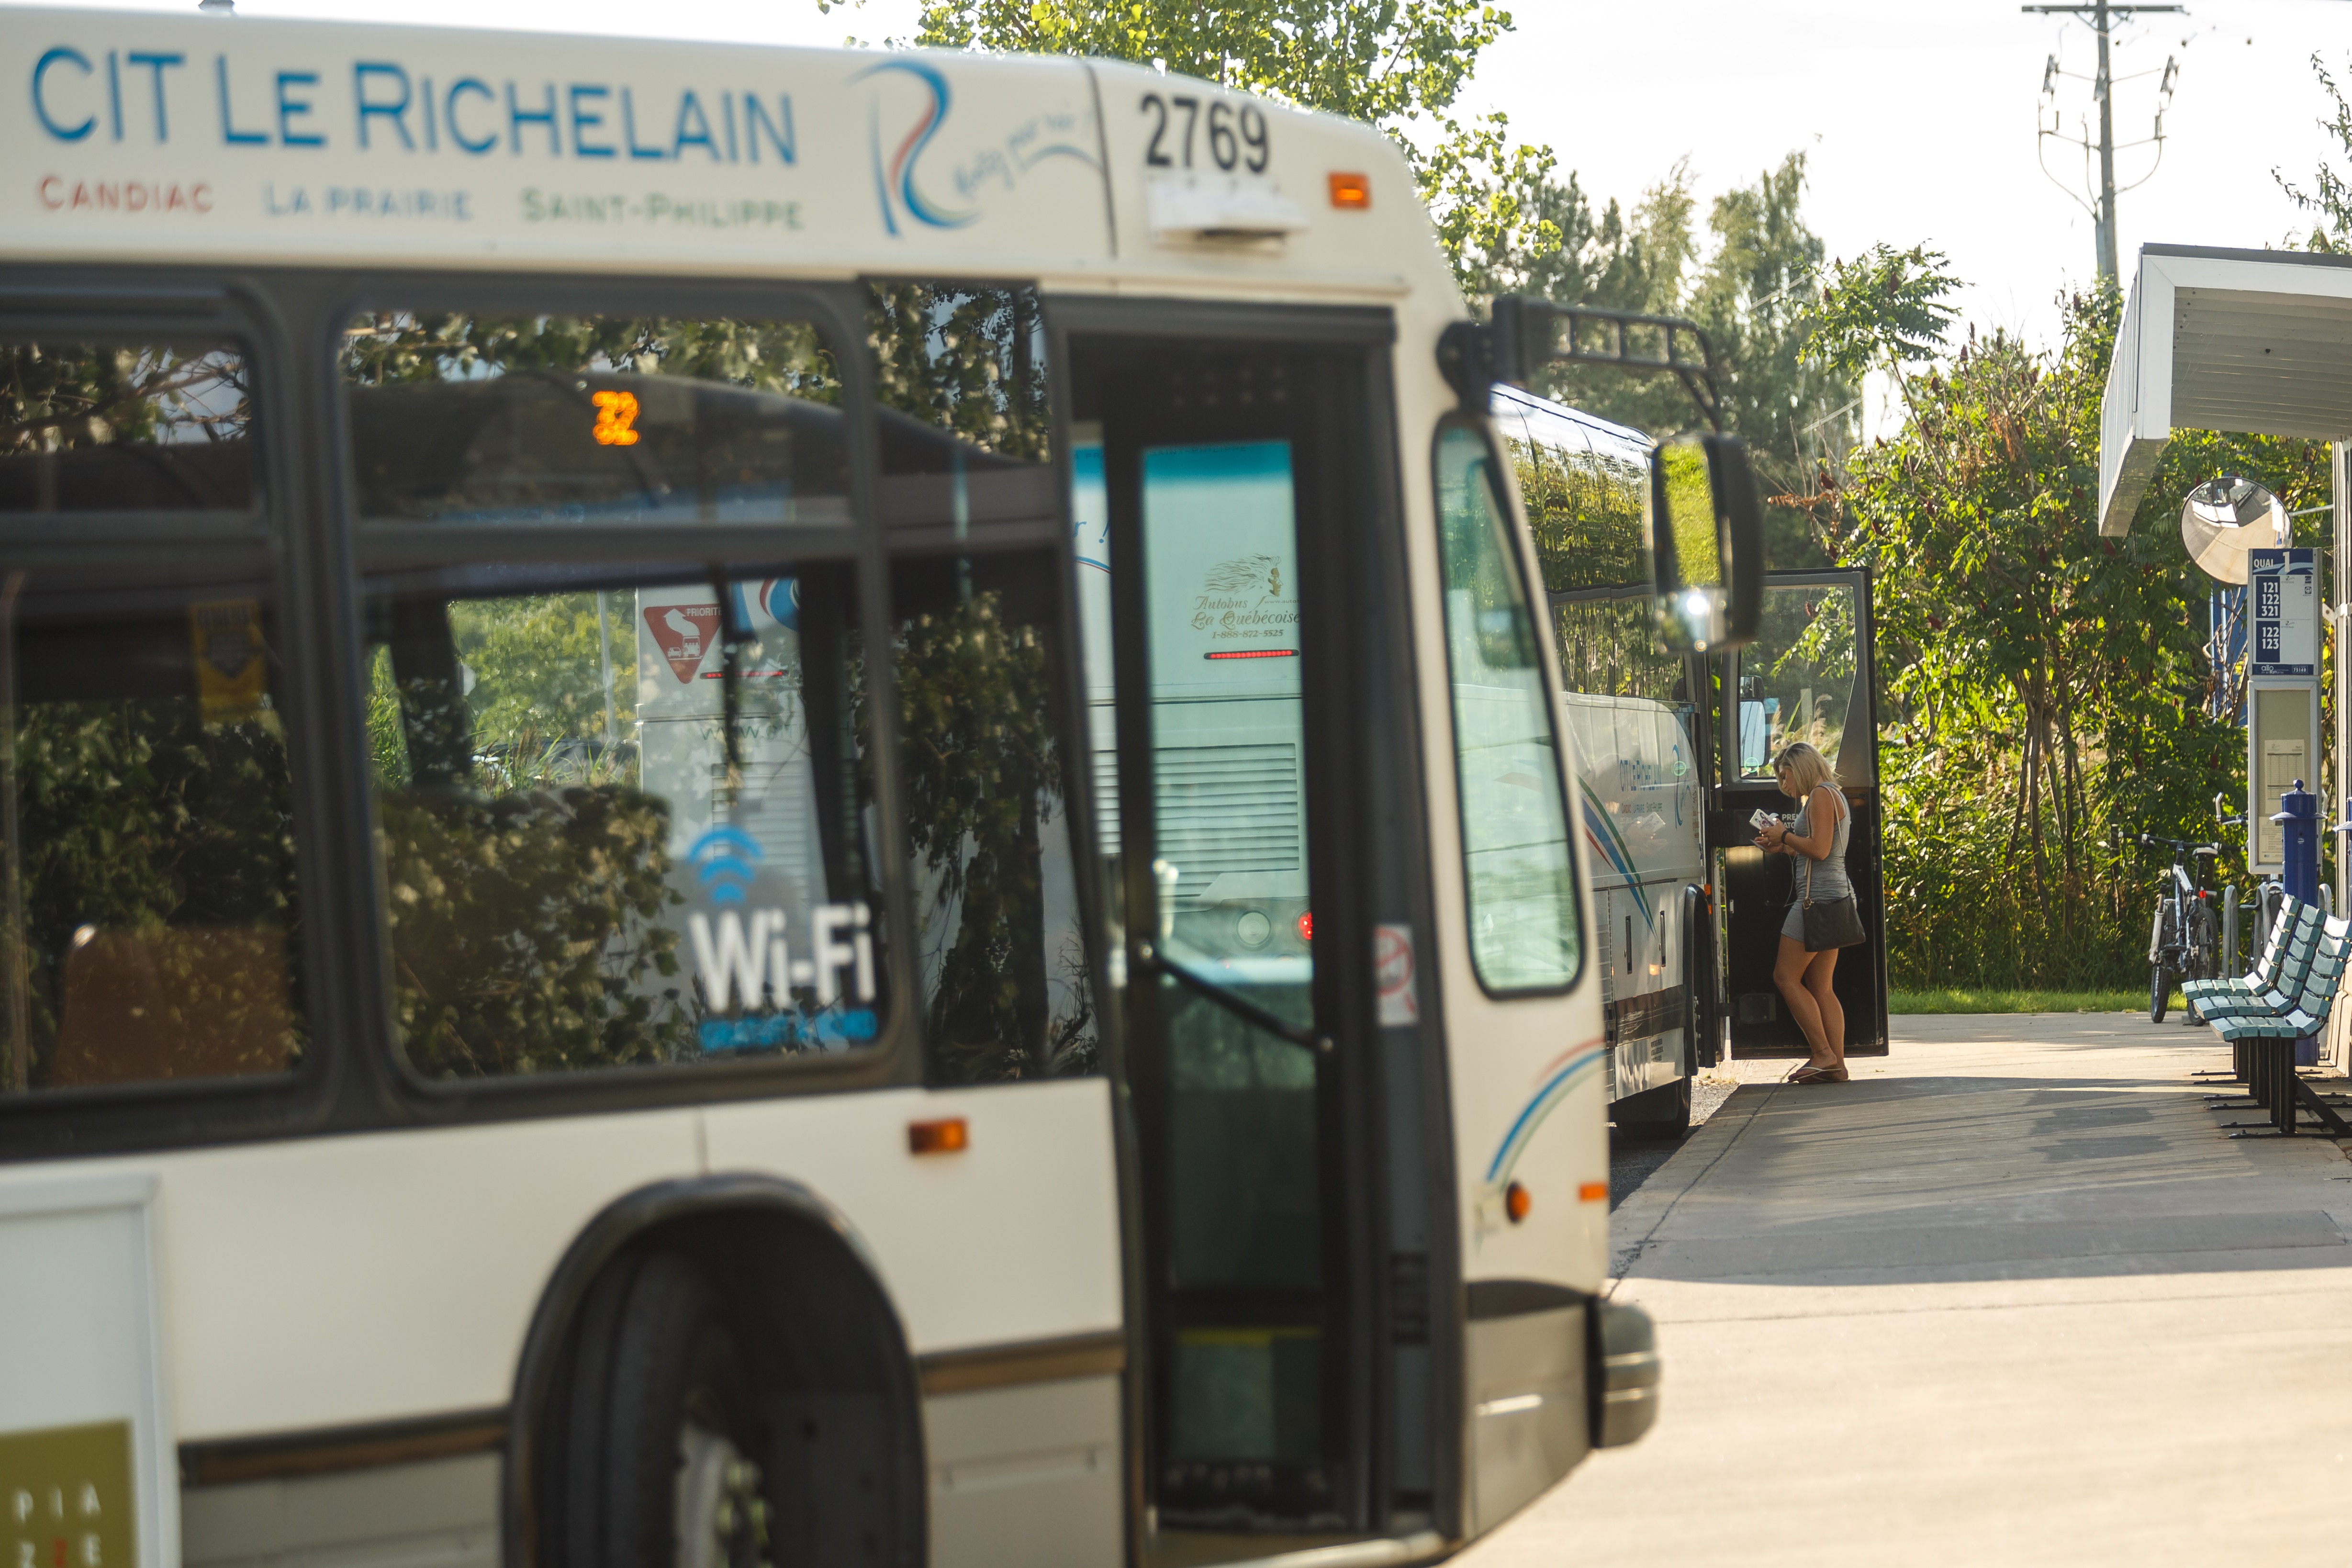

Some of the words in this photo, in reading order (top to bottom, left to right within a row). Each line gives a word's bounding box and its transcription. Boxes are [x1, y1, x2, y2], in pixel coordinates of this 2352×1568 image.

[30, 44, 186, 143] CIT
[215, 54, 327, 148] LE
[353, 59, 797, 165] RICHELAIN
[1141, 93, 1269, 174] 2769
[38, 174, 214, 214] CANDIAC
[266, 183, 312, 217] LA
[326, 188, 472, 221] PRAIRIE
[522, 188, 804, 229] SAINT-PHILIPPE
[2254, 559, 2273, 568] QUAI
[2283, 551, 2290, 572] 1
[2263, 582, 2278, 593] 121
[1193, 596, 1248, 610] Autobus
[2262, 594, 2279, 605] 122
[2262, 606, 2278, 616] 321
[1191, 612, 1214, 630] La
[1220, 610, 1300, 630] Québécoise
[1212, 629, 1284, 639] 1-888-872-5525
[2262, 627, 2279, 638] 122
[2262, 638, 2279, 650] 123
[688, 902, 876, 1012] Wi-Fi
